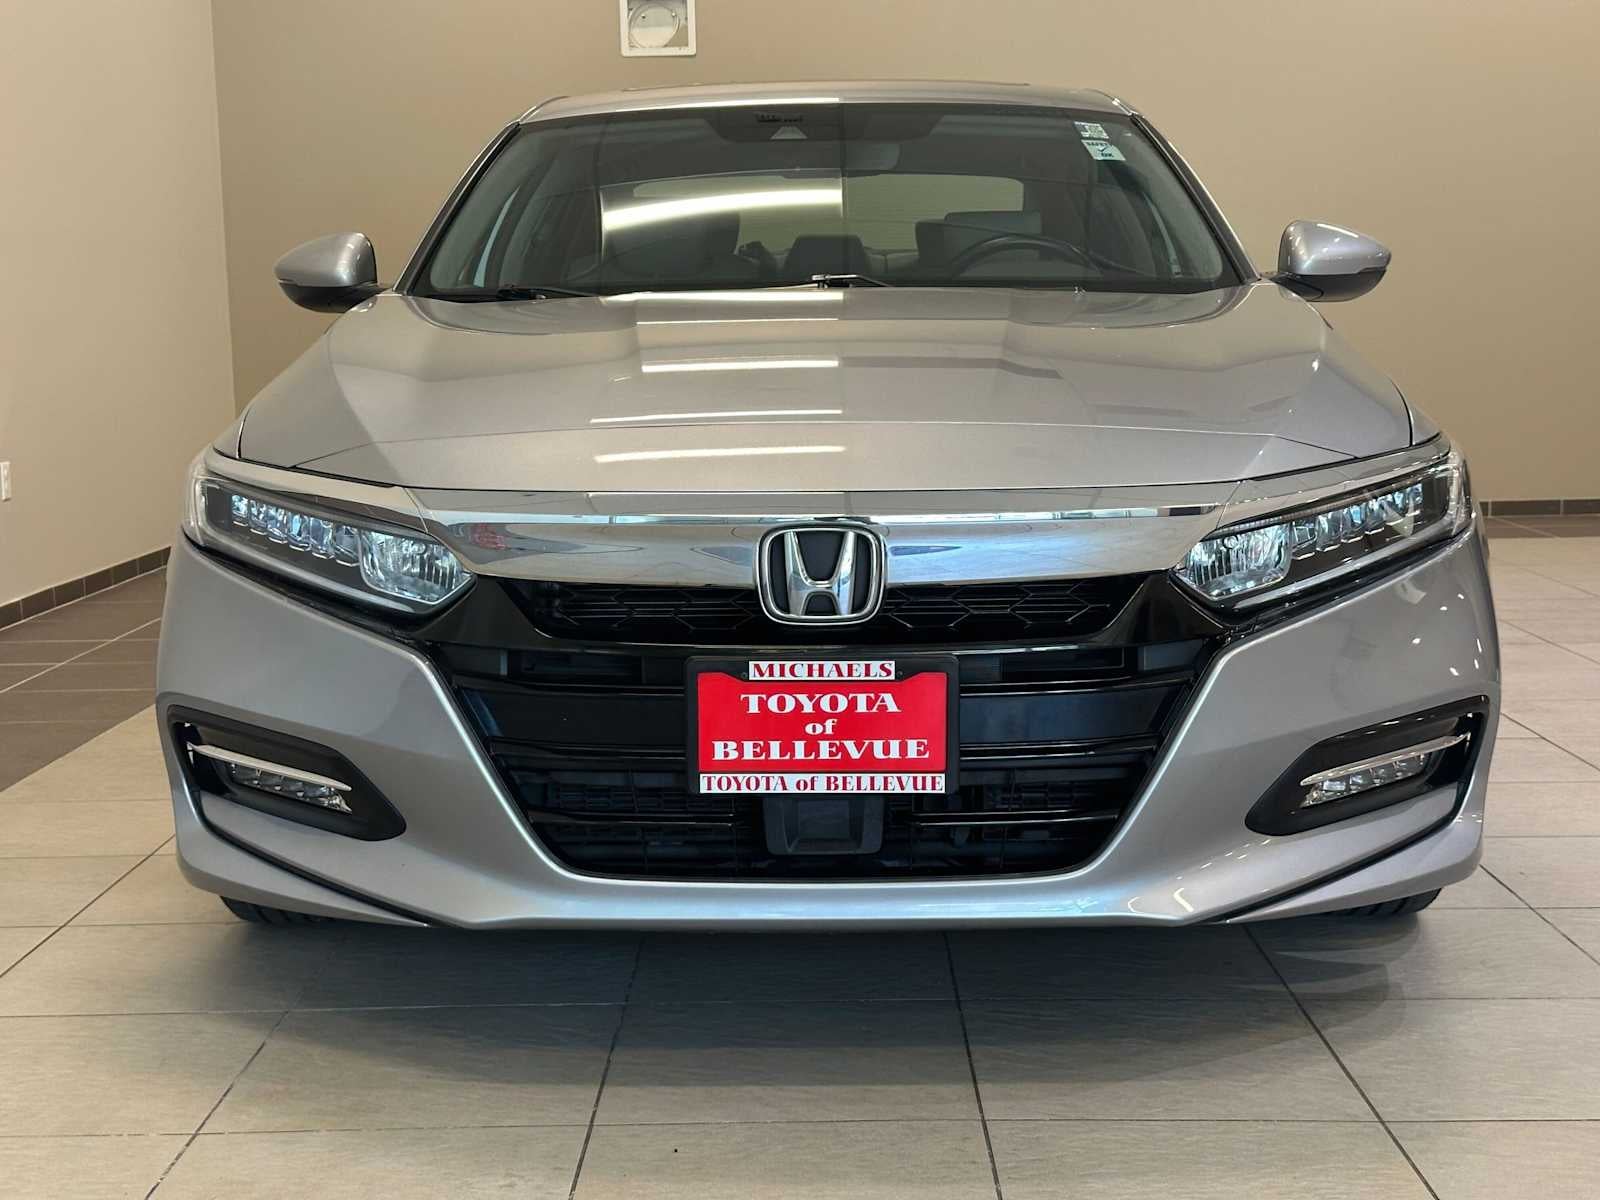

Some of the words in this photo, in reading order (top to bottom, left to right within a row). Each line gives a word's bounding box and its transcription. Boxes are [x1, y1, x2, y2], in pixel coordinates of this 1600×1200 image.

[753, 662, 893, 678] MICHAELS
[740, 692, 901, 714] TOYOTA
[805, 718, 838, 736] of
[711, 739, 929, 760] BELLEVUE
[702, 775, 788, 791] TOYOTA
[795, 775, 819, 791] of
[826, 775, 943, 791] BELLEVUE
